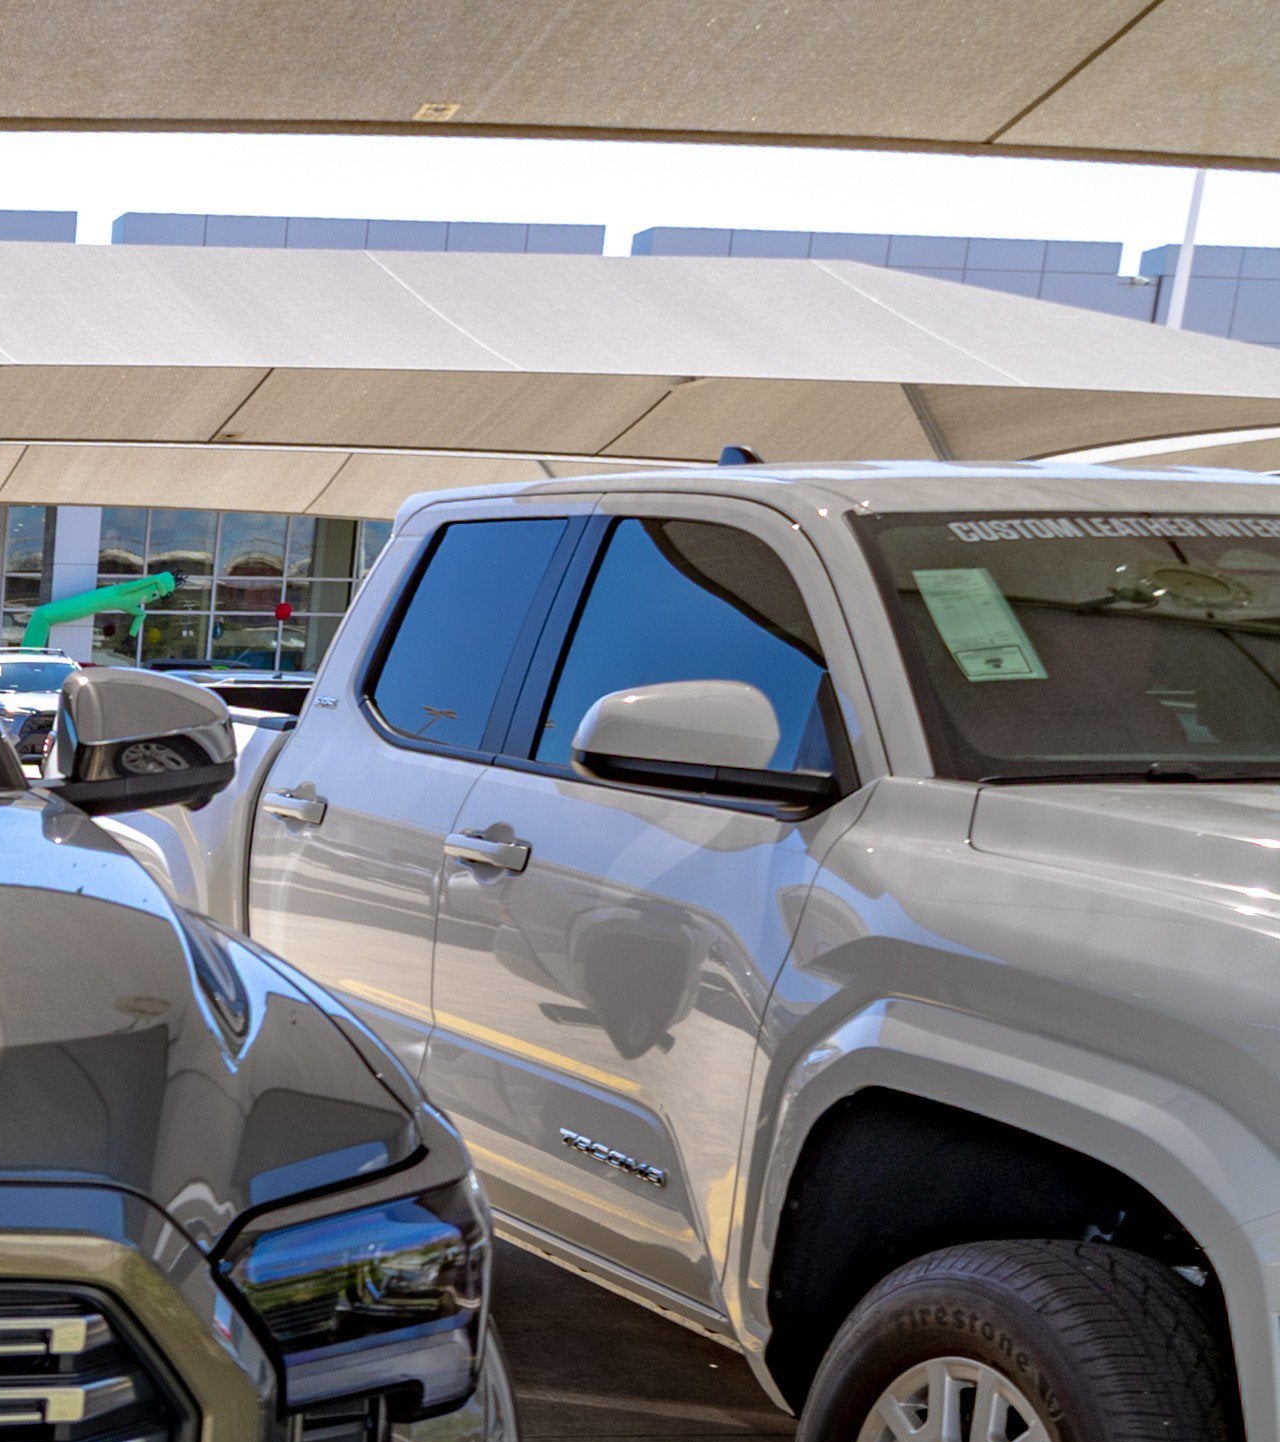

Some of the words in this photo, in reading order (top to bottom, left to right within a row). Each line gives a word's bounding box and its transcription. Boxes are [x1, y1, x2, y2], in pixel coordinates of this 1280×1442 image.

[948, 517, 1085, 543] CUSTOM
[1073, 516, 1209, 538] LEATHER
[559, 1127, 668, 1188] TACOMA
